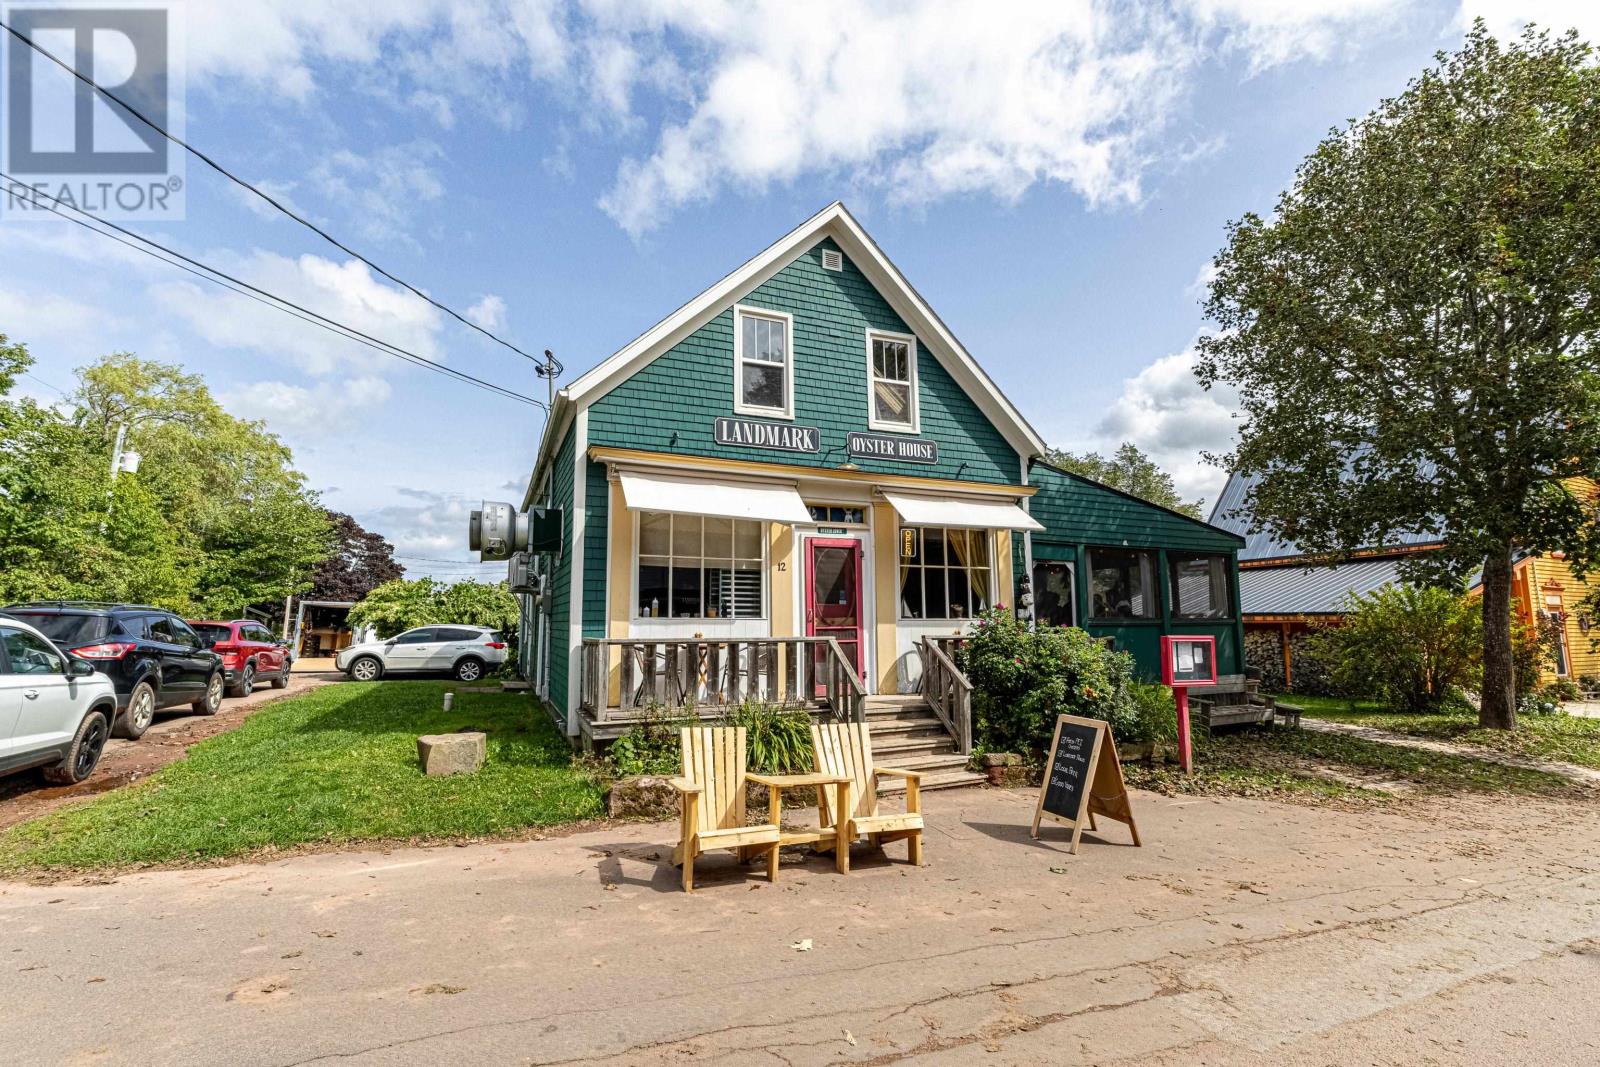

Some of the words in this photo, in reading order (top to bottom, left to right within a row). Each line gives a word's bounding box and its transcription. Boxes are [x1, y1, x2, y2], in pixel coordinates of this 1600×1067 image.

[721, 420, 814, 452] LANDMARK
[852, 437, 895, 456] OYSTER
[899, 441, 934, 459] HOUSE
[777, 562, 787, 572] 12
